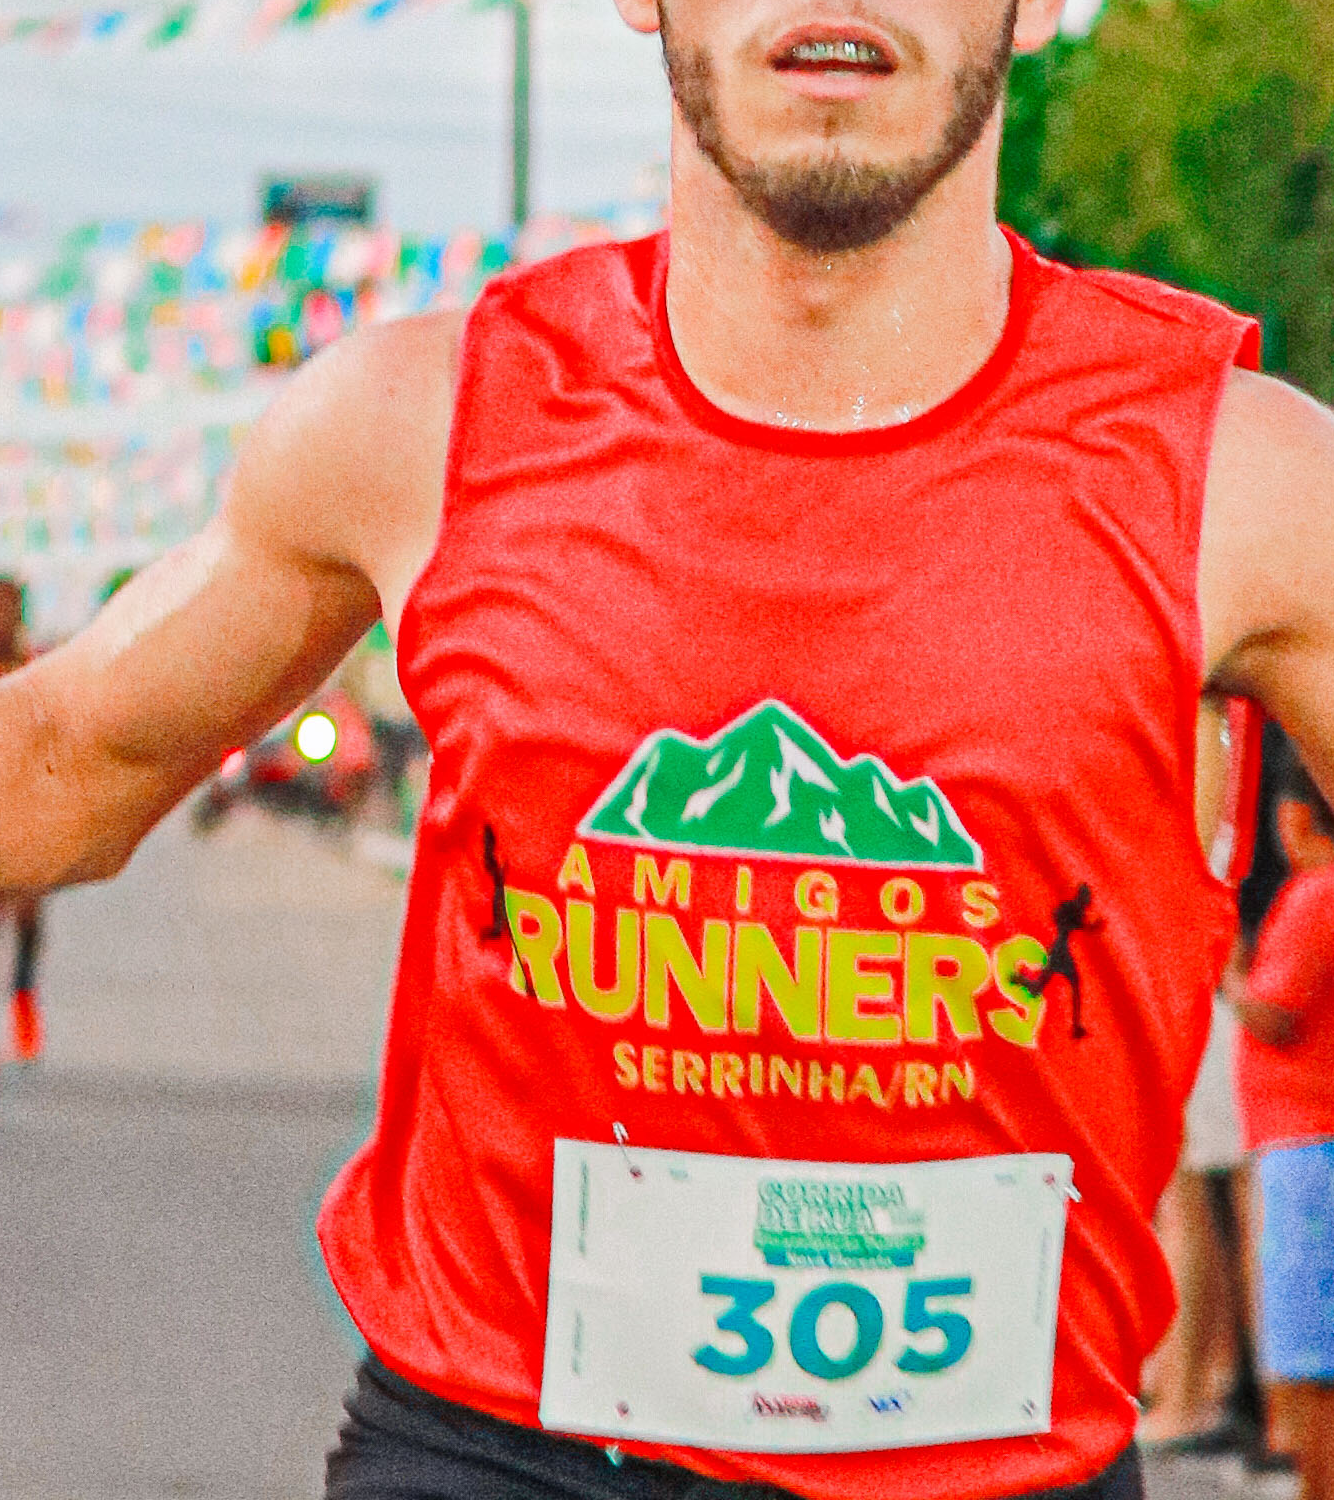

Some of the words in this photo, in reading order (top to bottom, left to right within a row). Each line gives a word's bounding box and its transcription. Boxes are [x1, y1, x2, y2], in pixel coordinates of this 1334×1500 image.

[557, 843, 1002, 928] AMIGOS
[504, 886, 1053, 1048] RUNNERS
[611, 1040, 977, 1110] SERRINHA/RN
[757, 1177, 907, 1206] CORRIDA
[692, 1272, 973, 1381] 305
